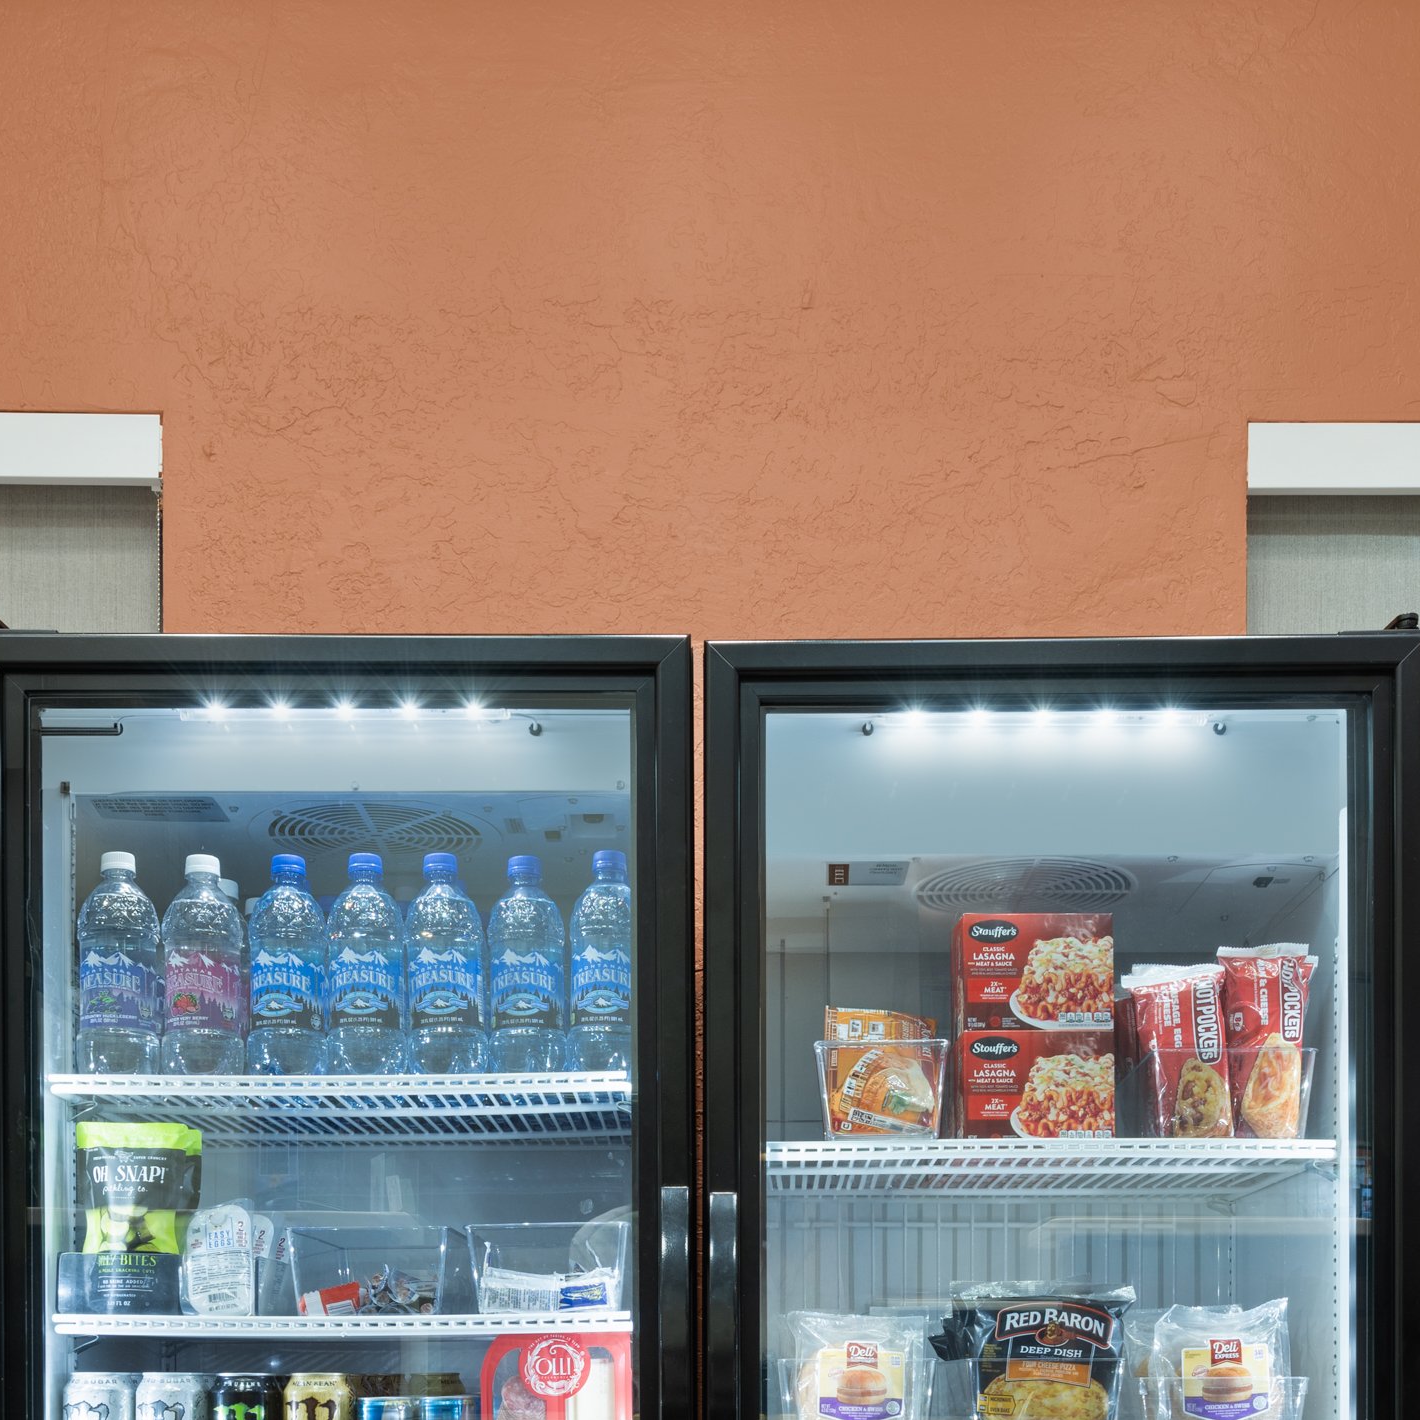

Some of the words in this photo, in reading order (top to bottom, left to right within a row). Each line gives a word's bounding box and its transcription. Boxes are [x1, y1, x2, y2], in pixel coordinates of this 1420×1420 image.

[972, 1042, 1018, 1055] Stouffer's
[93, 1166, 108, 1183] OH
[115, 1165, 165, 1183] SNAP!
[1006, 1310, 1041, 1330] RED
[1043, 1308, 1105, 1338] BARON
[1020, 1346, 1050, 1355] DEEP
[1053, 1348, 1082, 1358] DISH
[536, 1357, 571, 1376] OLLI
